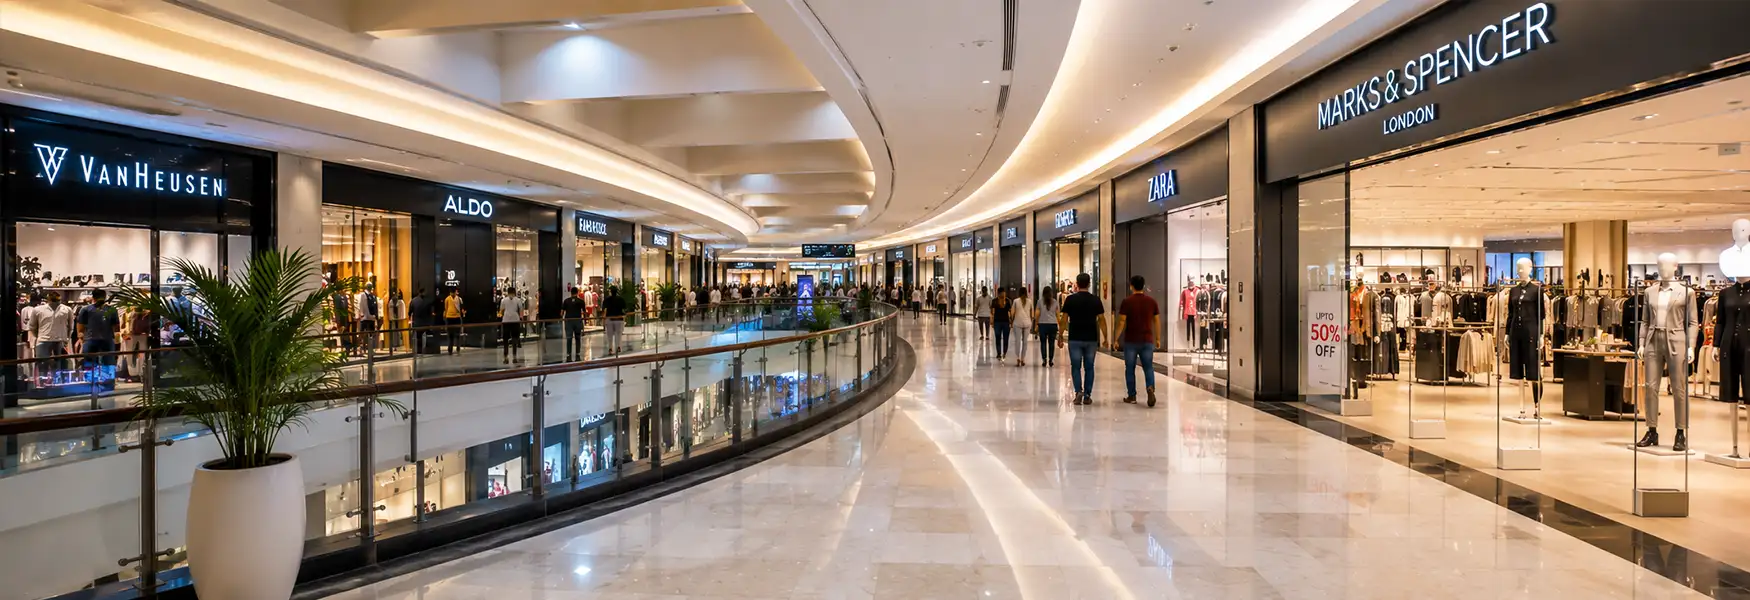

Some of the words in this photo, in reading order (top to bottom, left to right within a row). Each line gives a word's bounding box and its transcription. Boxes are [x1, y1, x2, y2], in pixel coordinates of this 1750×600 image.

[1317, 75, 1381, 130] MARKS
[1384, 69, 1400, 104] &
[1403, 2, 1550, 97] SPENCER
[1383, 103, 1435, 135] LONDON
[1147, 169, 1177, 203] ZARA
[443, 193, 493, 218] ALDO
[1315, 312, 1334, 321] UPTO
[1311, 323, 1341, 343] 50%
[1315, 344, 1336, 358] OFF
